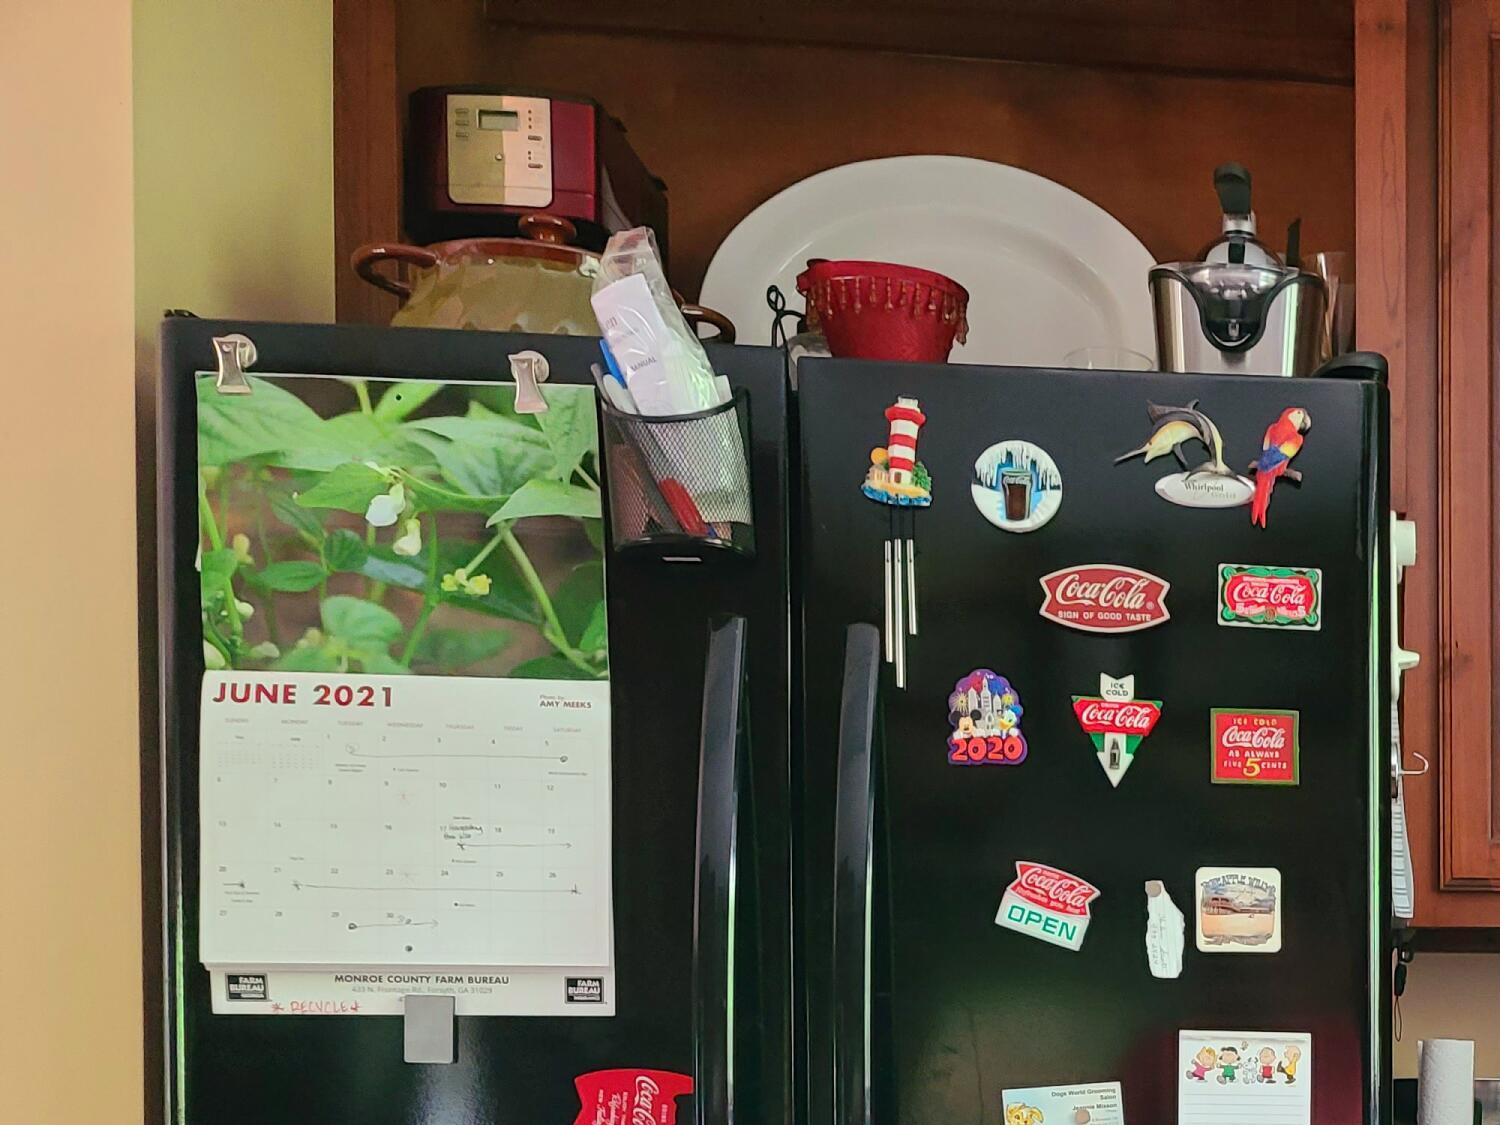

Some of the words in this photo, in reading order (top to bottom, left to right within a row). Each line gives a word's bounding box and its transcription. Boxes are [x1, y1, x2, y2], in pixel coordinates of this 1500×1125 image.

[1184, 482, 1224, 493] Whirlpool
[1056, 574, 1150, 610] Coca-Cola
[1233, 582, 1307, 605] Coca-Cola
[1058, 611, 1079, 619] SIGN
[1083, 612, 1095, 620] OF
[1098, 612, 1123, 620] GOOD
[1126, 613, 1152, 622] TASTE
[212, 682, 297, 704] JUNE
[313, 684, 392, 708] 2021
[563, 701, 592, 709] MEEKS
[1082, 704, 1153, 729] Coca-Cola
[1222, 726, 1286, 749] Coca-Cola
[952, 736, 1023, 761] 2020
[1229, 750, 1240, 758] AS
[1245, 751, 1280, 759] ALWAYS
[1223, 760, 1242, 768] FIVE
[1243, 758, 1261, 777] 5
[1261, 762, 1287, 770] CENTS
[1021, 867, 1093, 908] Coca-Cola
[1008, 904, 1077, 941] OPEN
[239, 977, 264, 985] FARM
[335, 975, 383, 984] MONROE
[387, 975, 431, 984] COUNTY
[435, 976, 464, 984] FARM
[467, 976, 510, 985] BUREAU
[577, 979, 600, 987] FARM
[229, 984, 265, 993] BUREAU
[568, 987, 601, 995] BUREAU
[1051, 1091, 1067, 1099] Dogs
